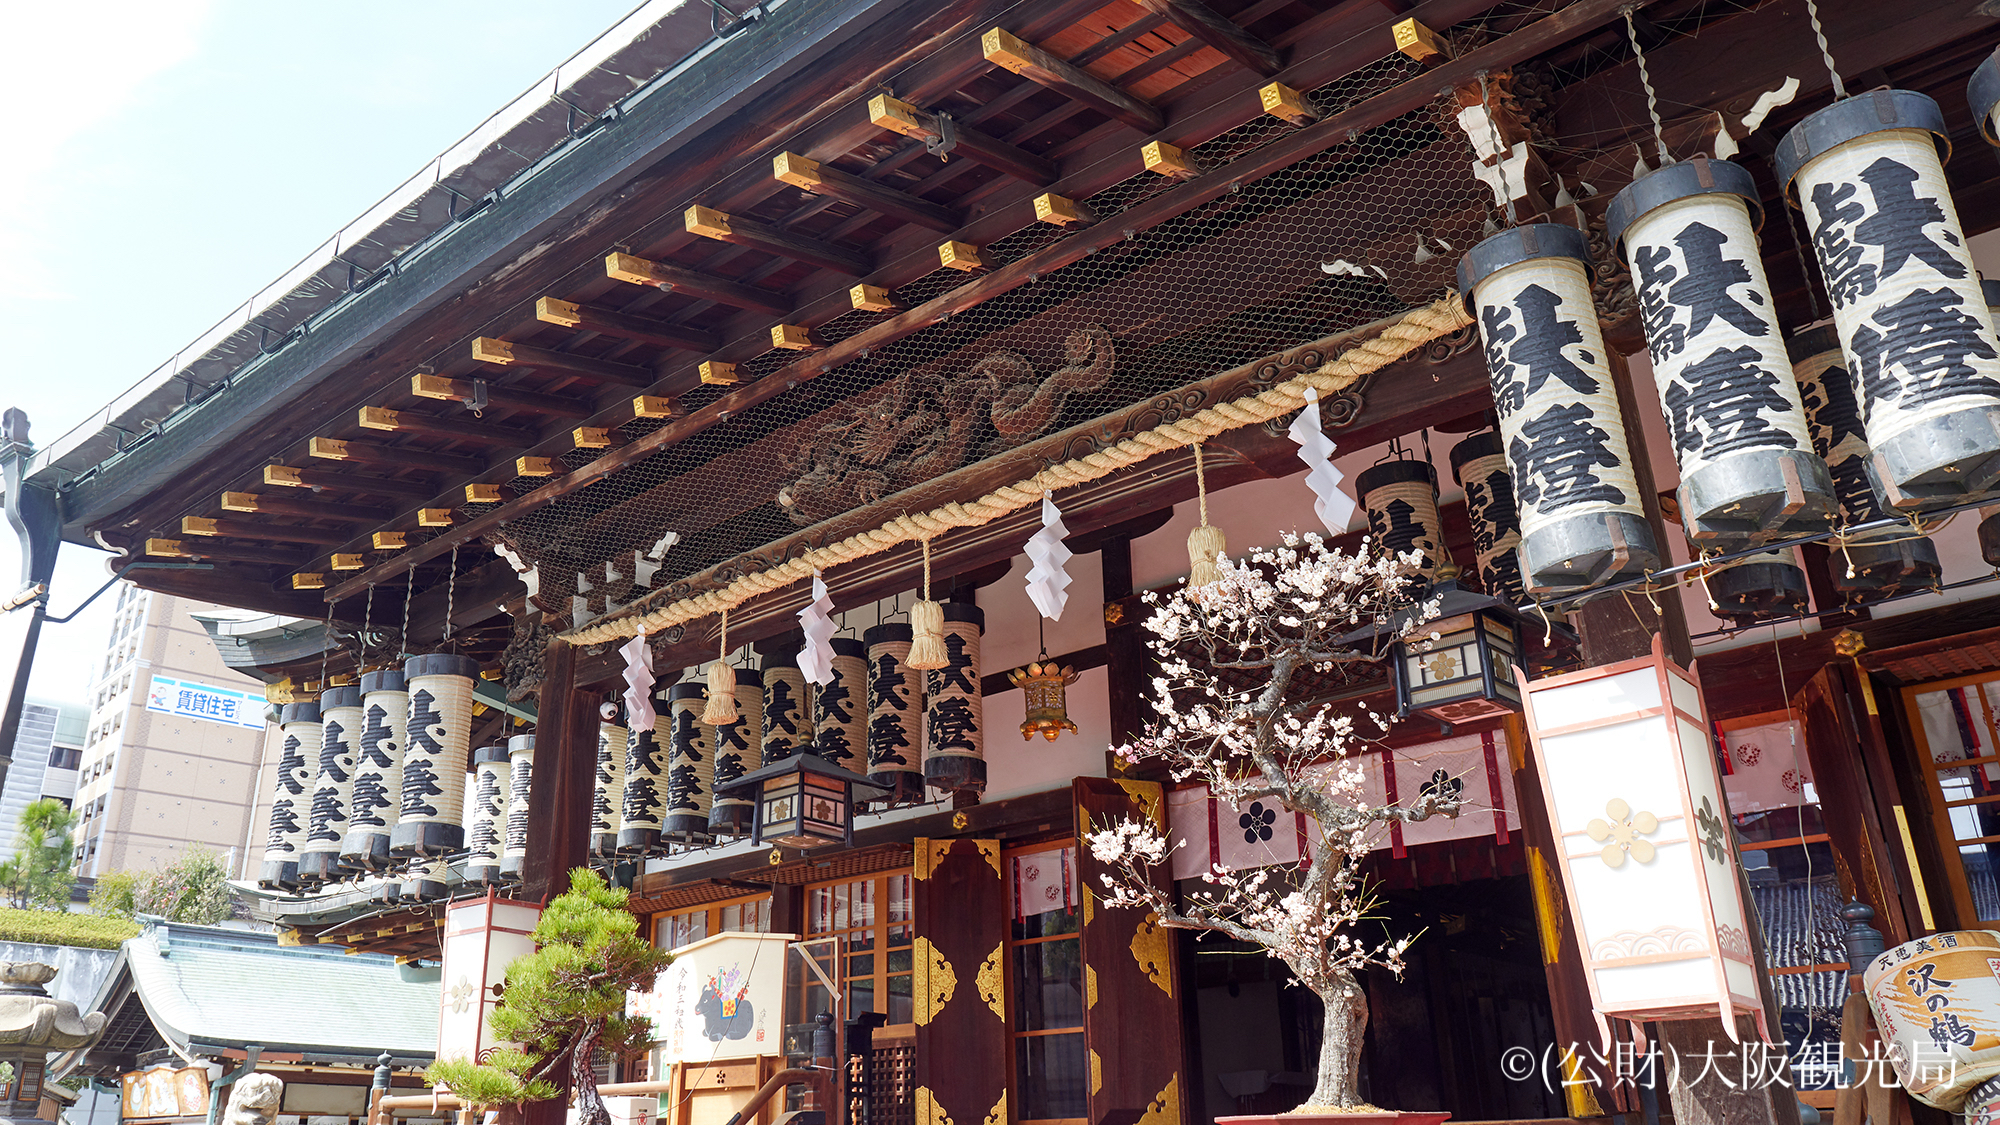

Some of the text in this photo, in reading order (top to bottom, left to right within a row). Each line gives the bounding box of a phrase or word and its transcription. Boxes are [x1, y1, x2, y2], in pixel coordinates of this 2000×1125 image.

[176, 689, 236, 718] 賃貸住宅
[1906, 963, 1976, 1053] 沢の鶴
